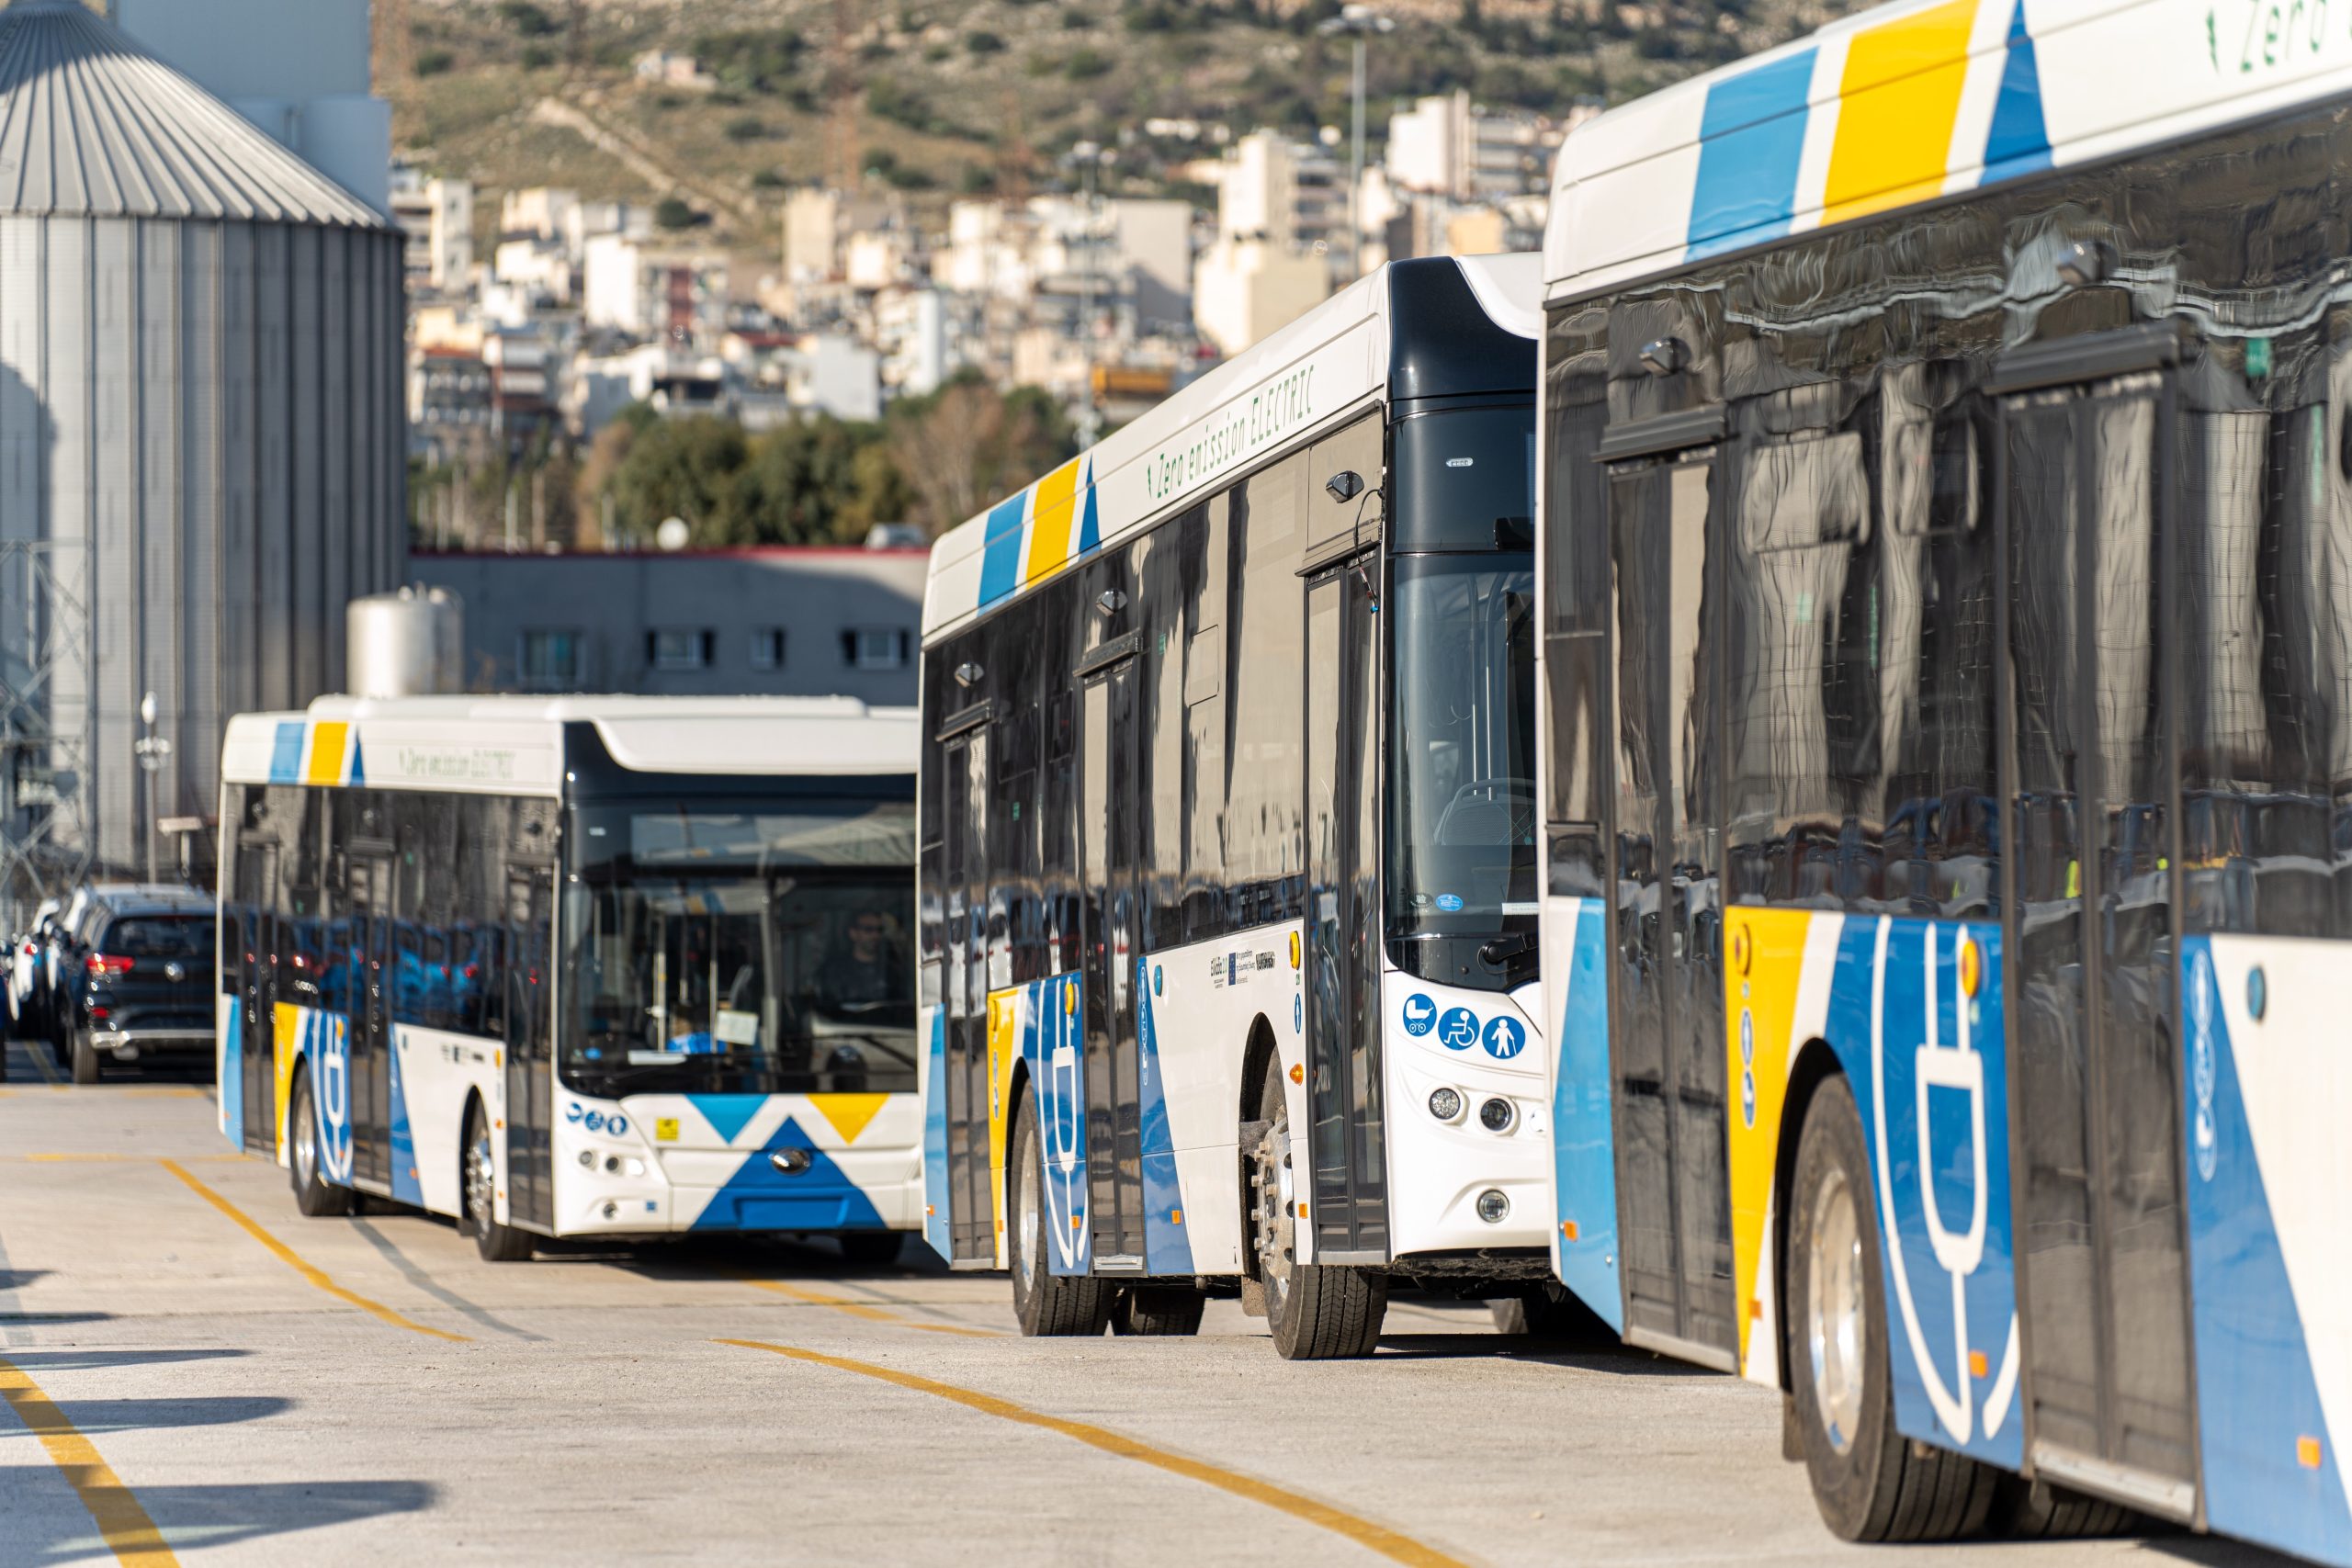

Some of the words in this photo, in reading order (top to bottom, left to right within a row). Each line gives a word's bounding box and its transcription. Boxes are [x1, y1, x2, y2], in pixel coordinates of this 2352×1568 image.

[2242, 0, 2327, 73] Zero
[1158, 454, 1183, 498] Zero
[1188, 412, 1246, 479] emission
[1250, 365, 1315, 445] ELECTRIC
